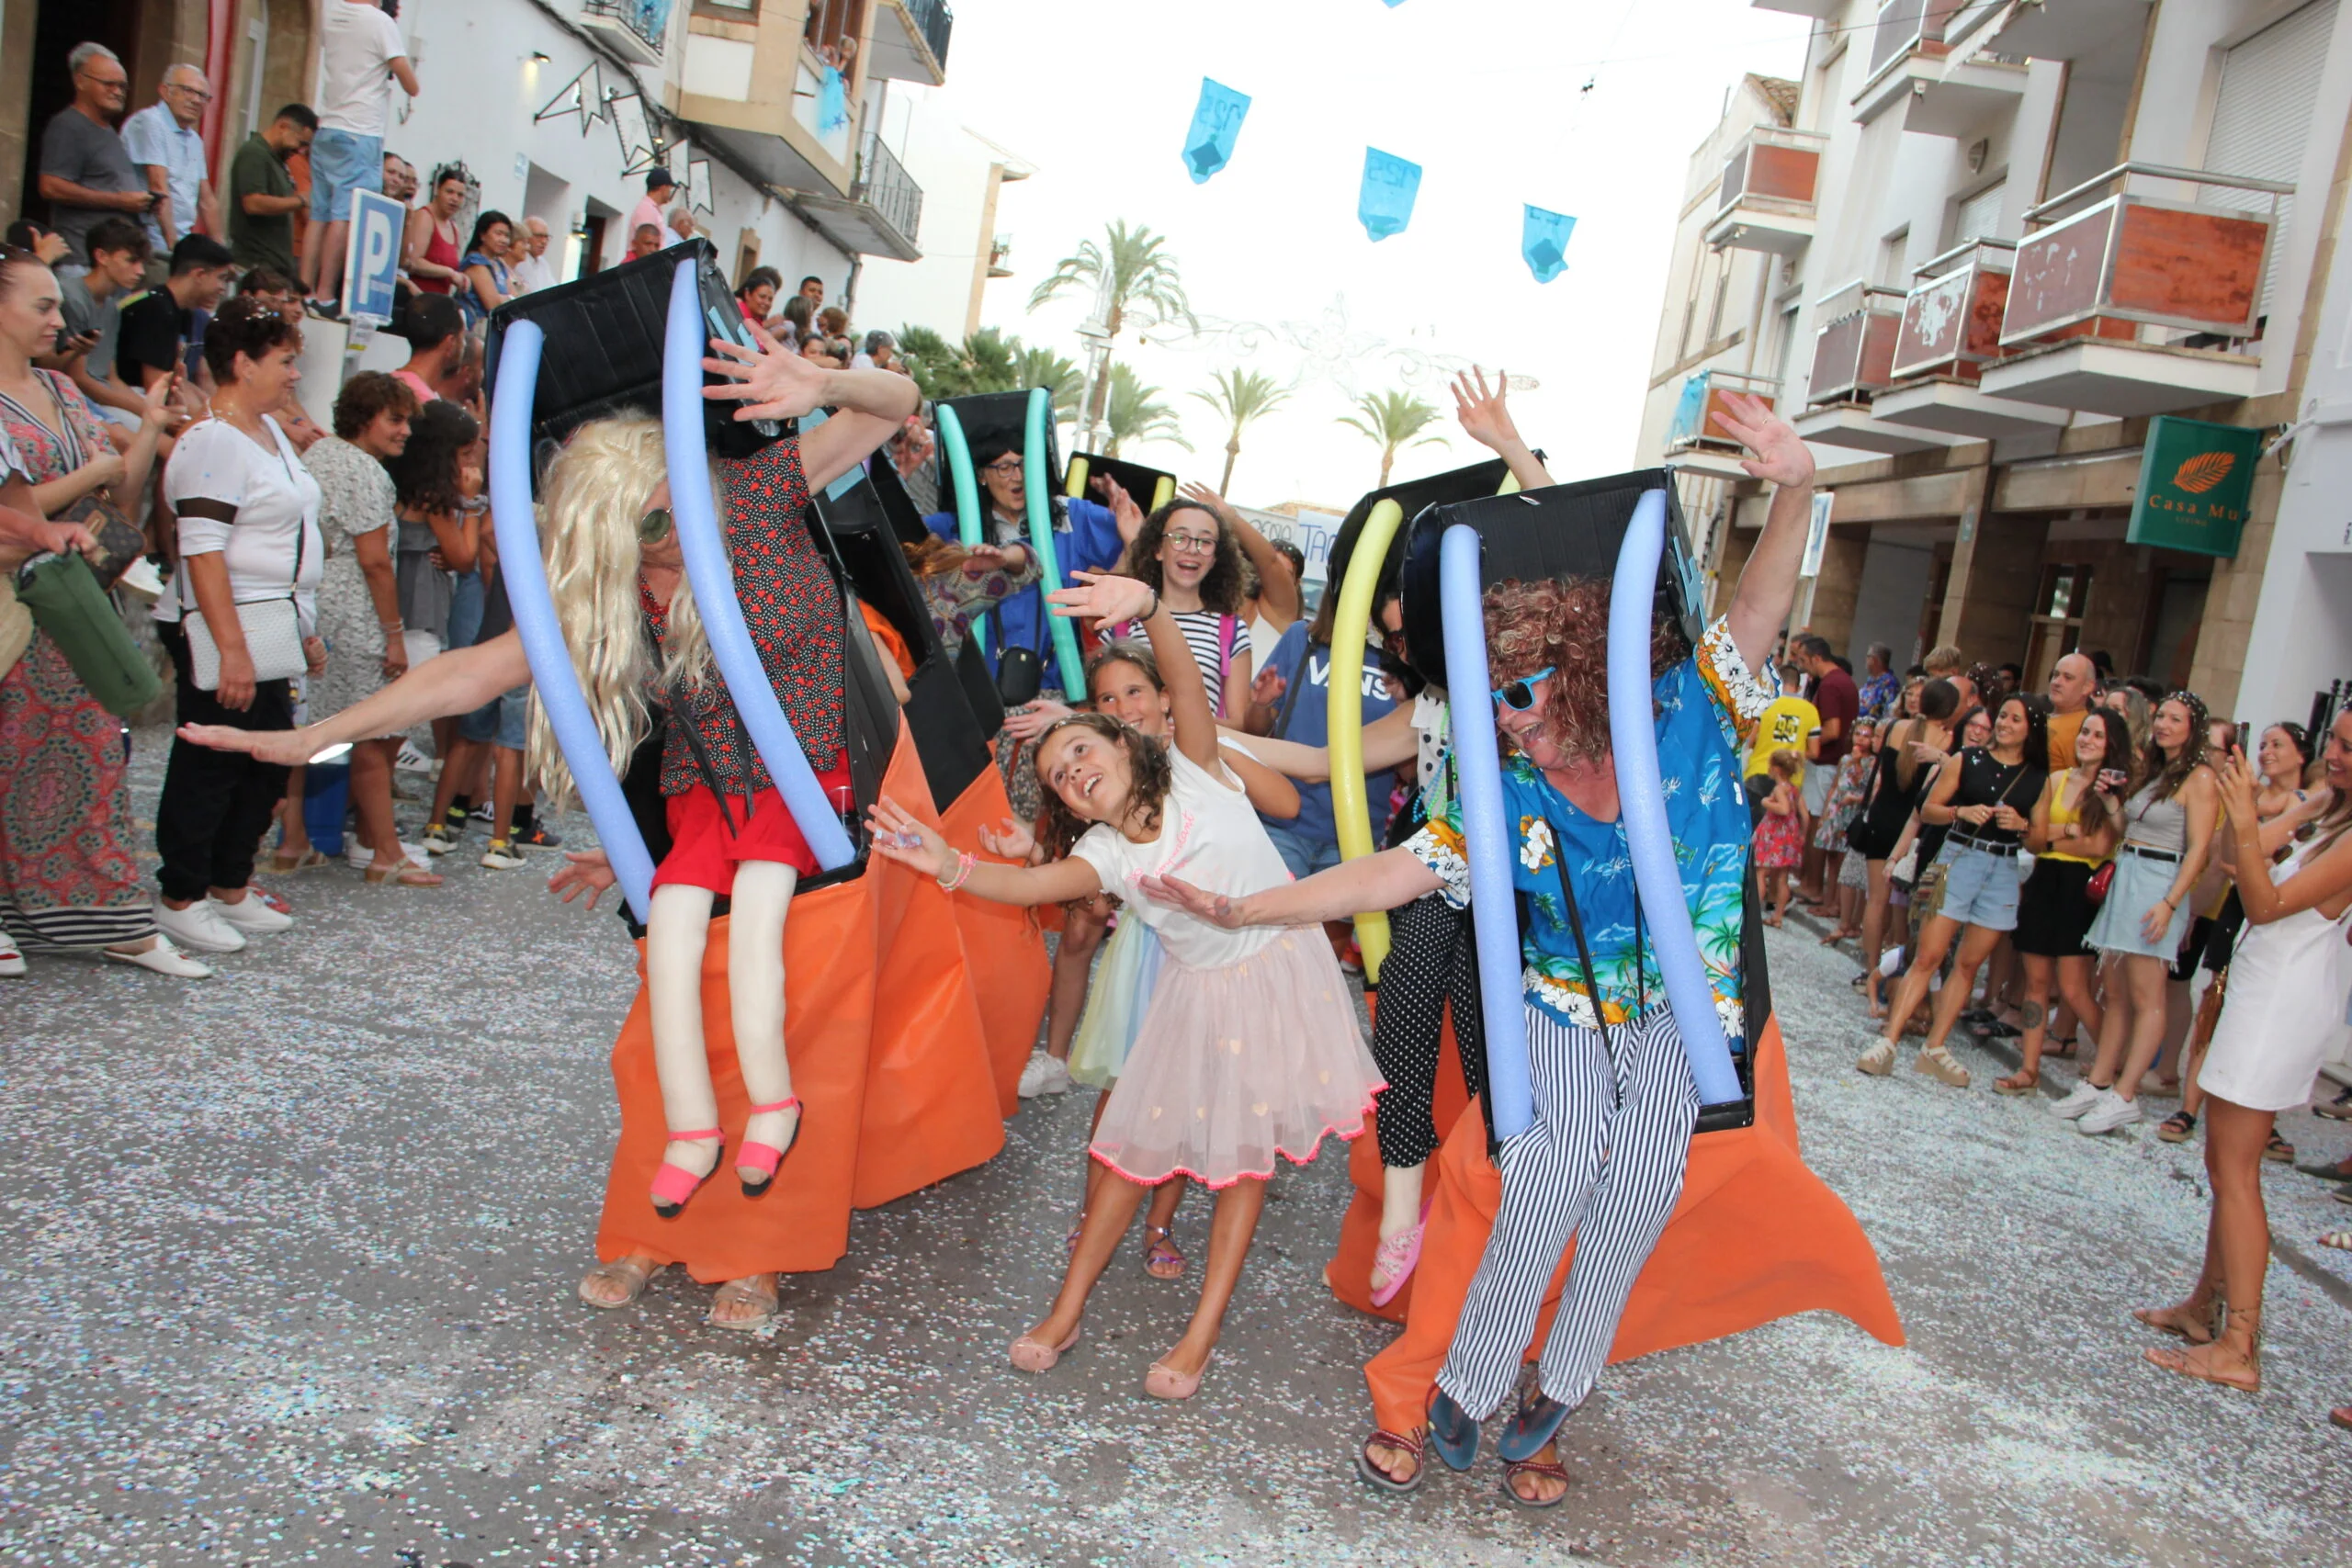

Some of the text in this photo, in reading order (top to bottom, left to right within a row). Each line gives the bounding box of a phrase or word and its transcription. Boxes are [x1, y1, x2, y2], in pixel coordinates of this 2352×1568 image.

[357, 209, 392, 305] P
[2148, 493, 2239, 521] Casa Mu
[1308, 655, 1392, 702] VNS
